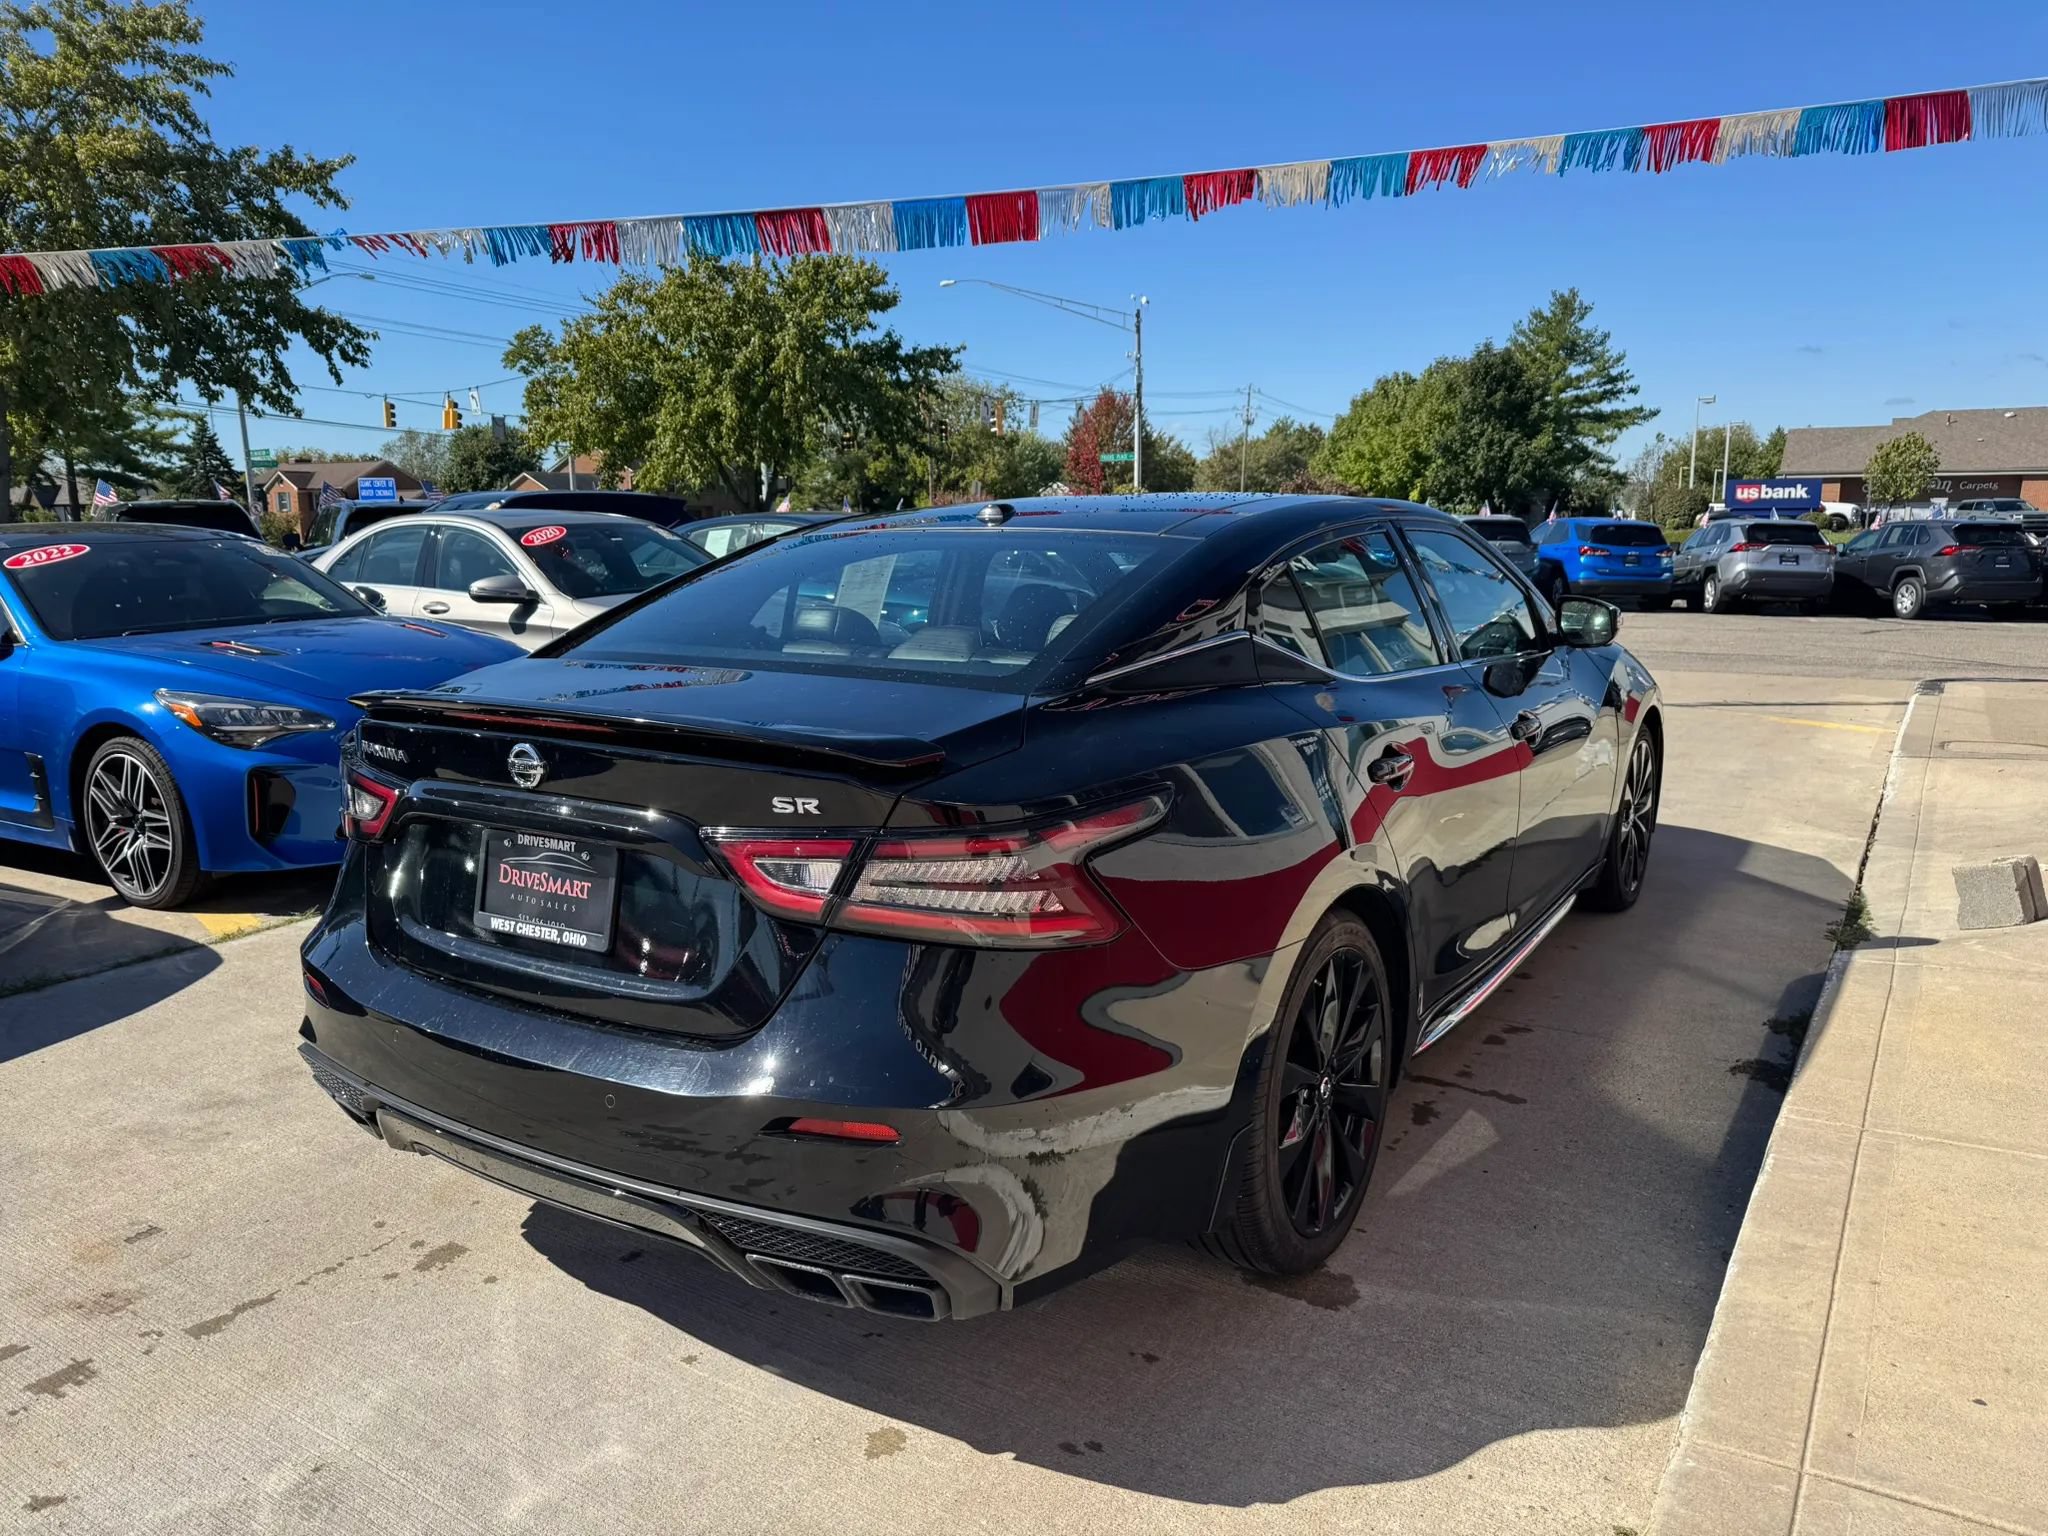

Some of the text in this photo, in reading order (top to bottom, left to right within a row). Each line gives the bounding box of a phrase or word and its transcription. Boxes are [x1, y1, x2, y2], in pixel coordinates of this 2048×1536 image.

[1959, 481, 1999, 492] Carpets
[528, 526, 560, 544] 2020
[19, 546, 75, 567] 2022
[361, 739, 408, 763] MAXIMA
[772, 796, 822, 814] SR
[518, 834, 576, 852] DRIVESMART
[510, 893, 576, 912] AUTO SALES
[490, 917, 588, 946] WEST CHESTER, OHIO
